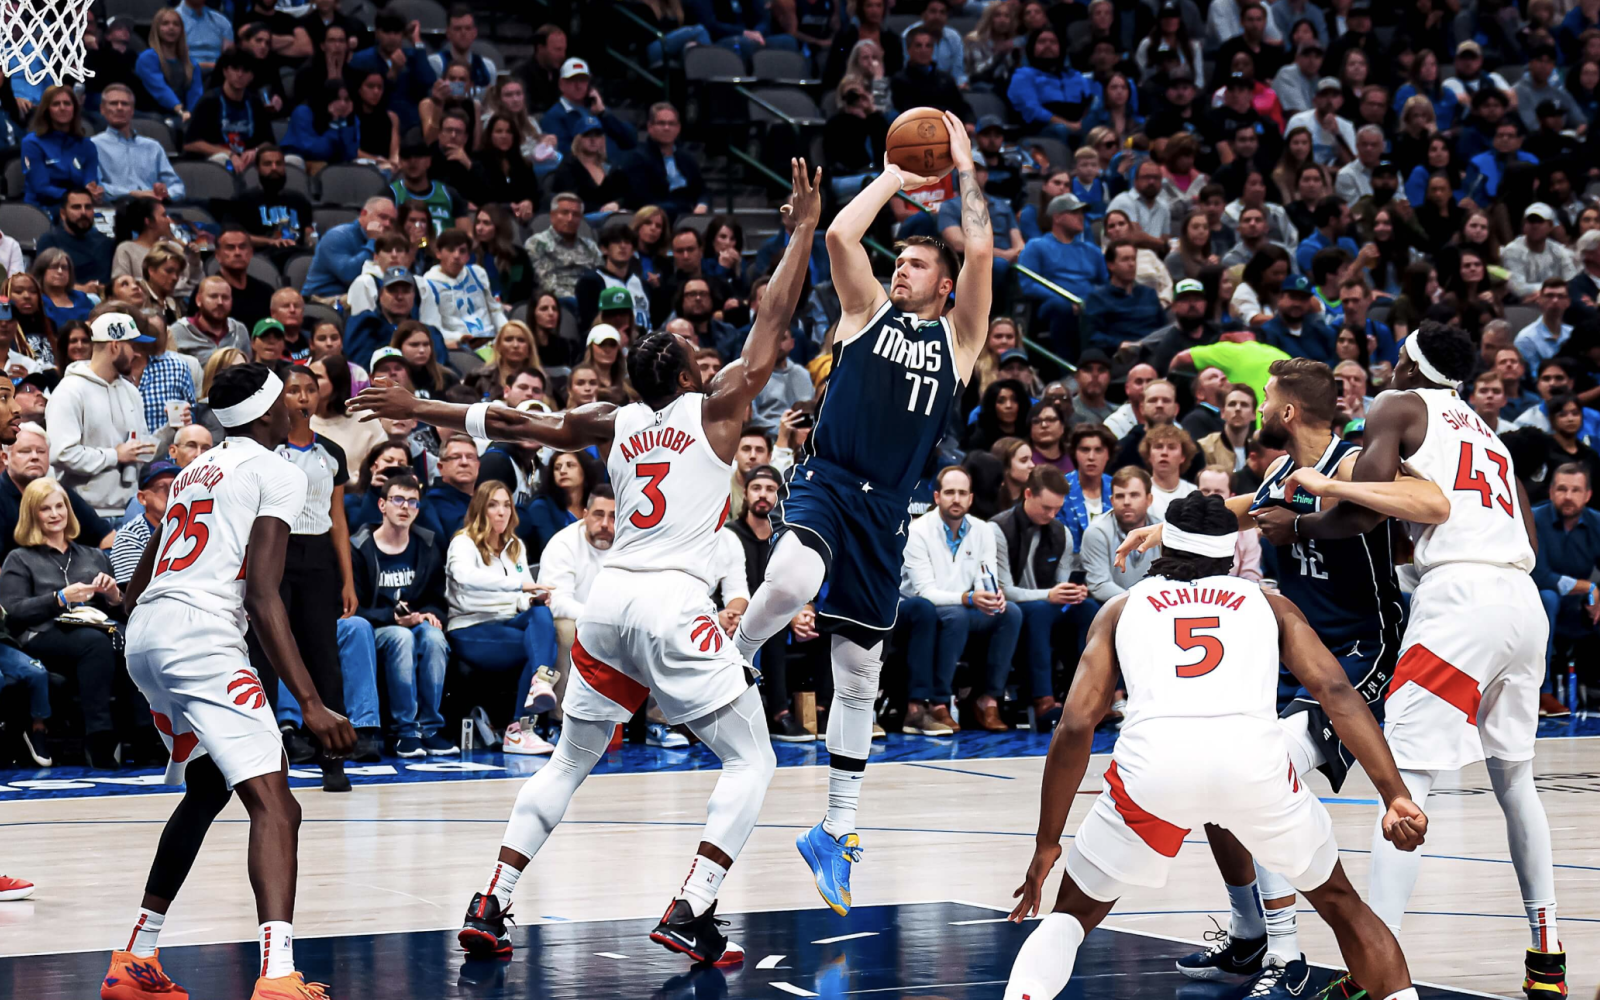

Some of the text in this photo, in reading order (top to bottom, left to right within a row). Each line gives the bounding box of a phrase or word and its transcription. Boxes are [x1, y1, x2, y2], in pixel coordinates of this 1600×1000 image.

[872, 324, 942, 372] MAVS
[905, 371, 939, 416] 77
[173, 465, 224, 499] BOUCHER
[629, 462, 670, 529] 3
[1453, 440, 1514, 519] 43
[154, 498, 214, 577] 25
[1146, 588, 1246, 612] ACHIUWA
[1174, 616, 1224, 678] 5
